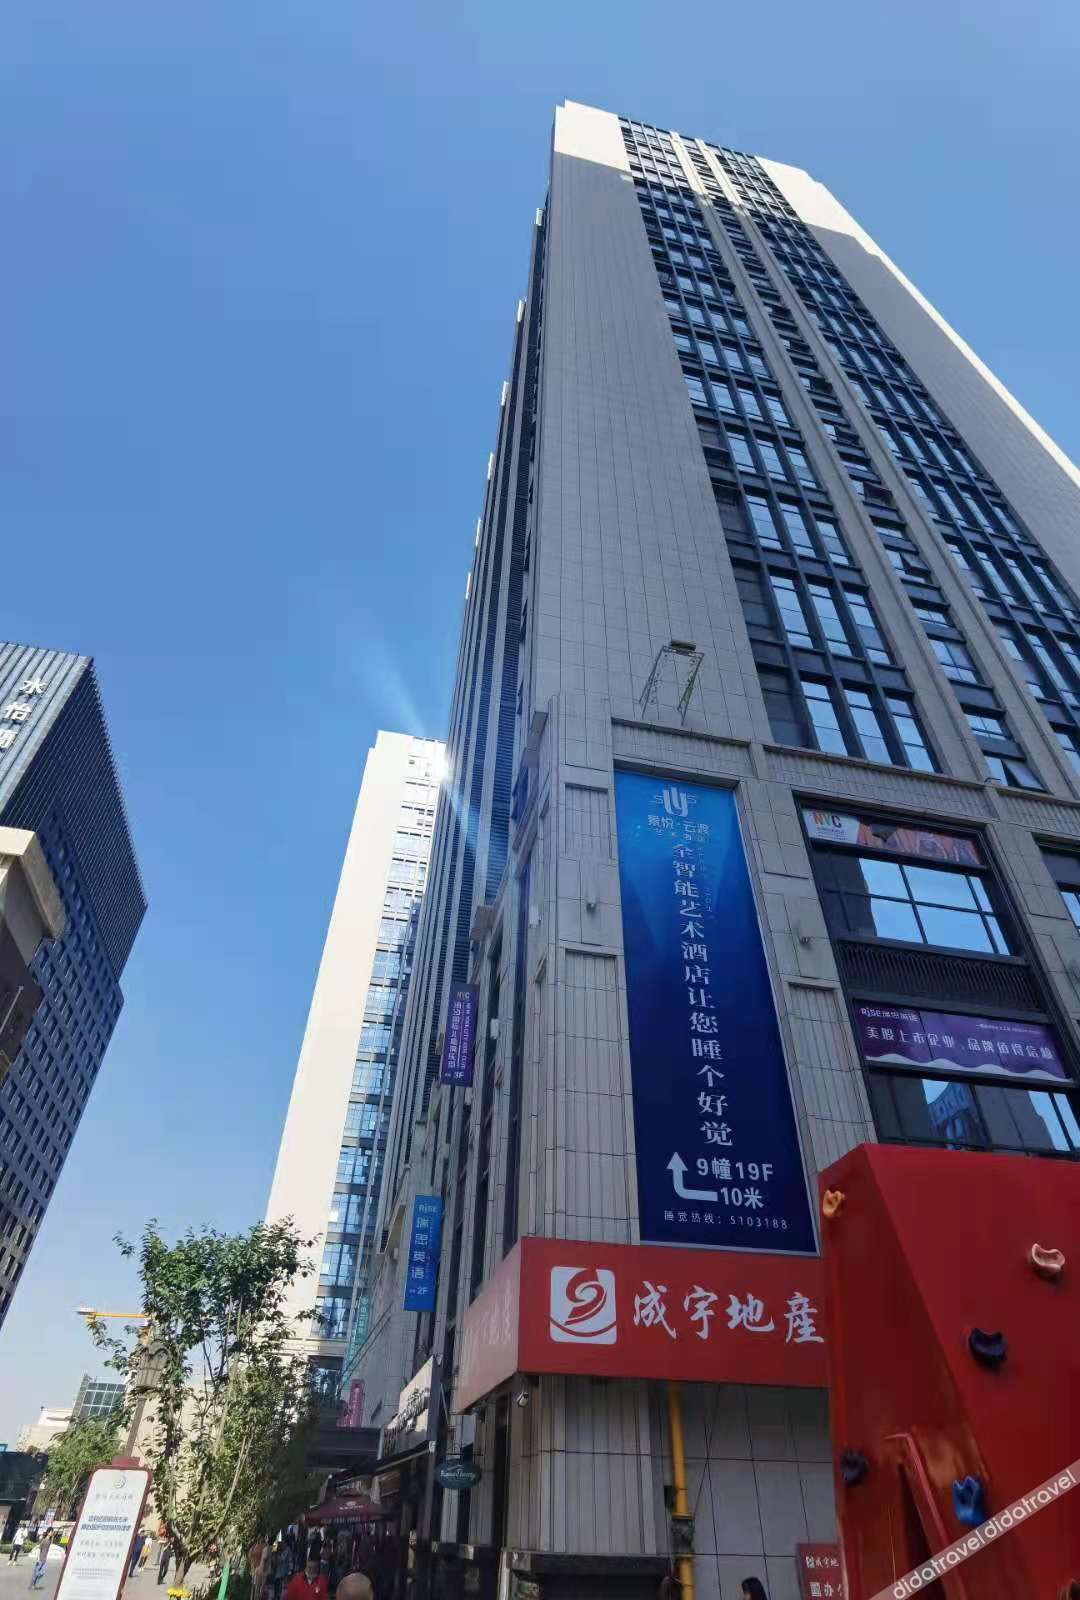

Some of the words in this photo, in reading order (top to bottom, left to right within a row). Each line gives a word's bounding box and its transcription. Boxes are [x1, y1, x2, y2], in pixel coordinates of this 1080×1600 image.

[672, 842, 734, 1147] 全智能艺术酒店让您睡个好觉
[696, 1157, 774, 1182] 9幢19F
[720, 1187, 765, 1209] 10米
